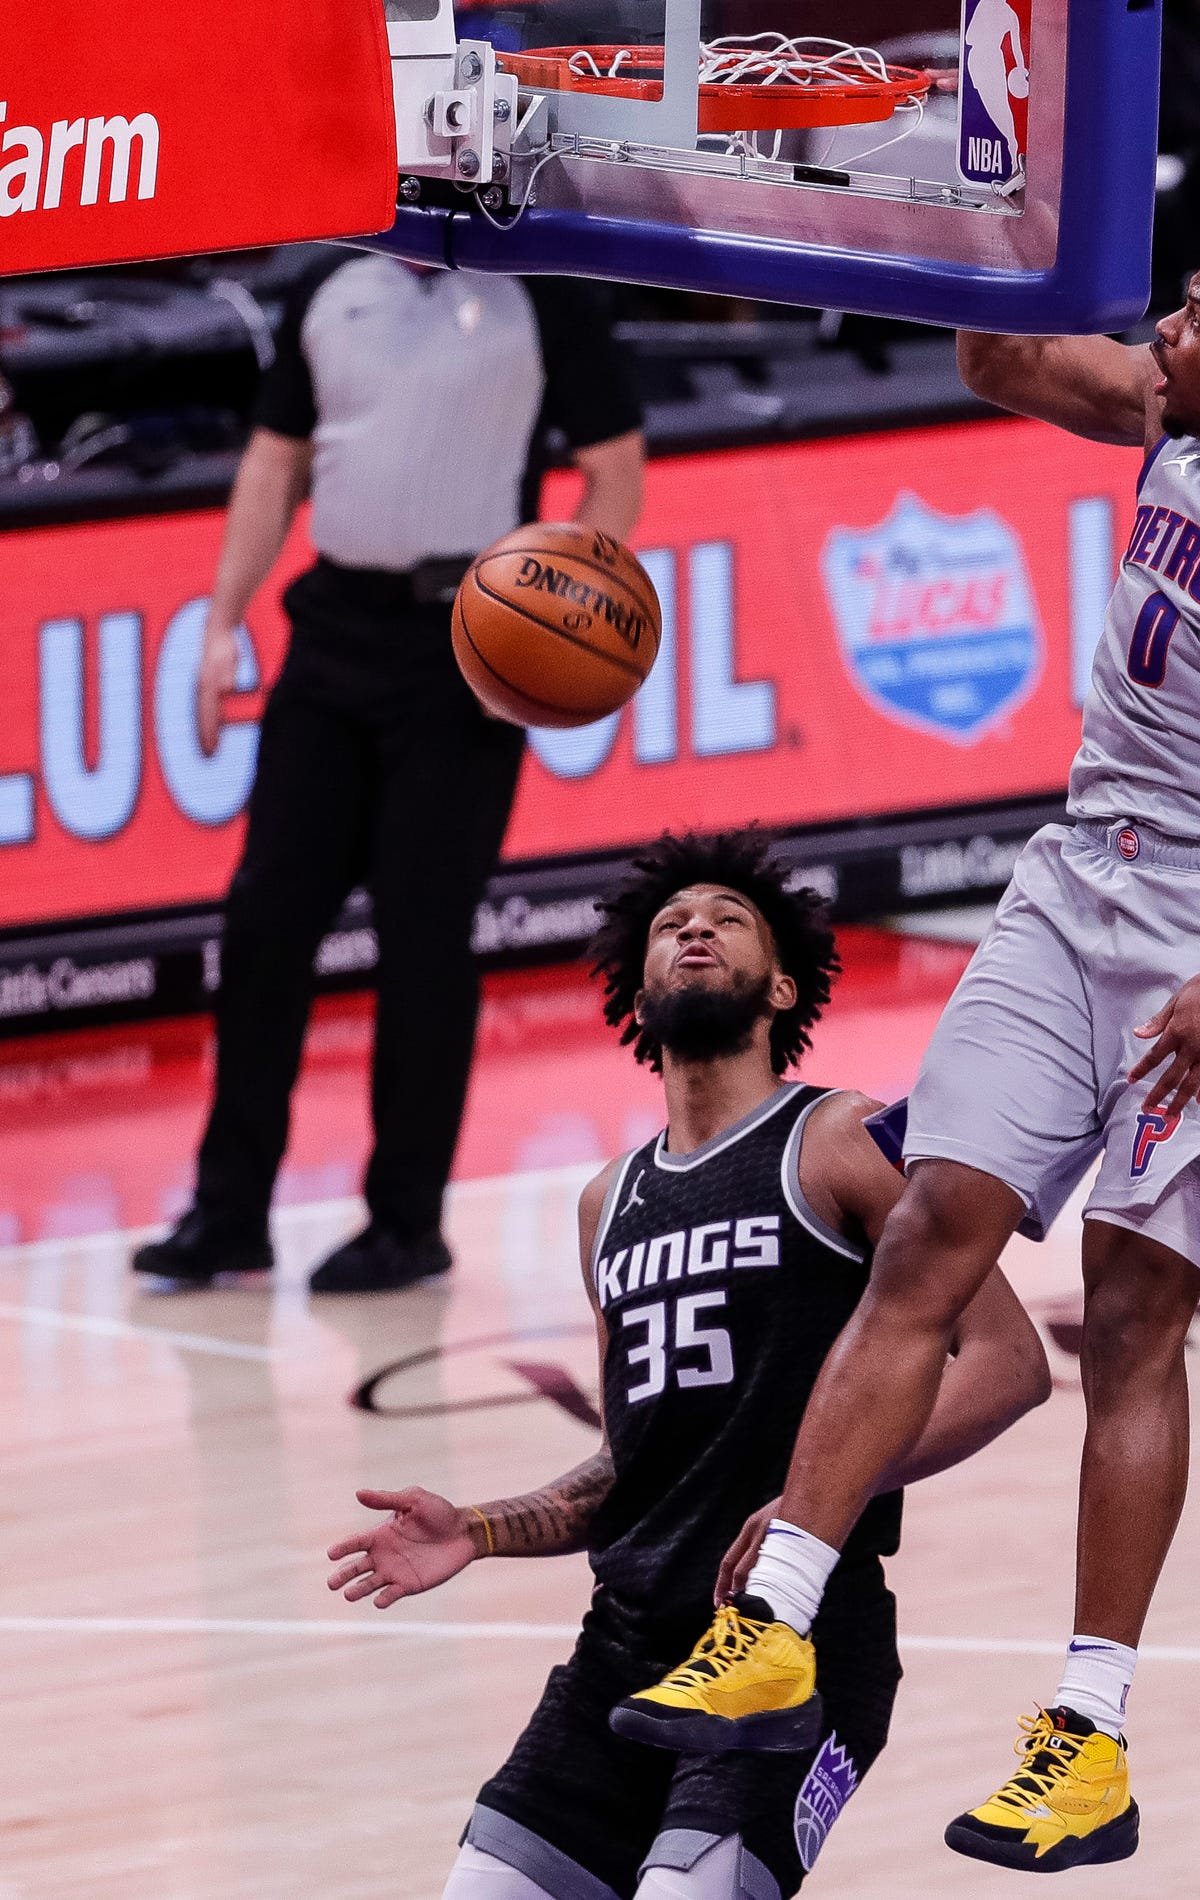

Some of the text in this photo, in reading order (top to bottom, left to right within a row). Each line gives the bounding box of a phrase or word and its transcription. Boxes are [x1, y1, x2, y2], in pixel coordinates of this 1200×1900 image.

[0, 101, 160, 218] arm
[967, 136, 1003, 175] NBA
[525, 539, 777, 781] IL
[1127, 590, 1181, 689] 0
[598, 1215, 780, 1309] KINGS
[622, 1290, 735, 1404] 35
